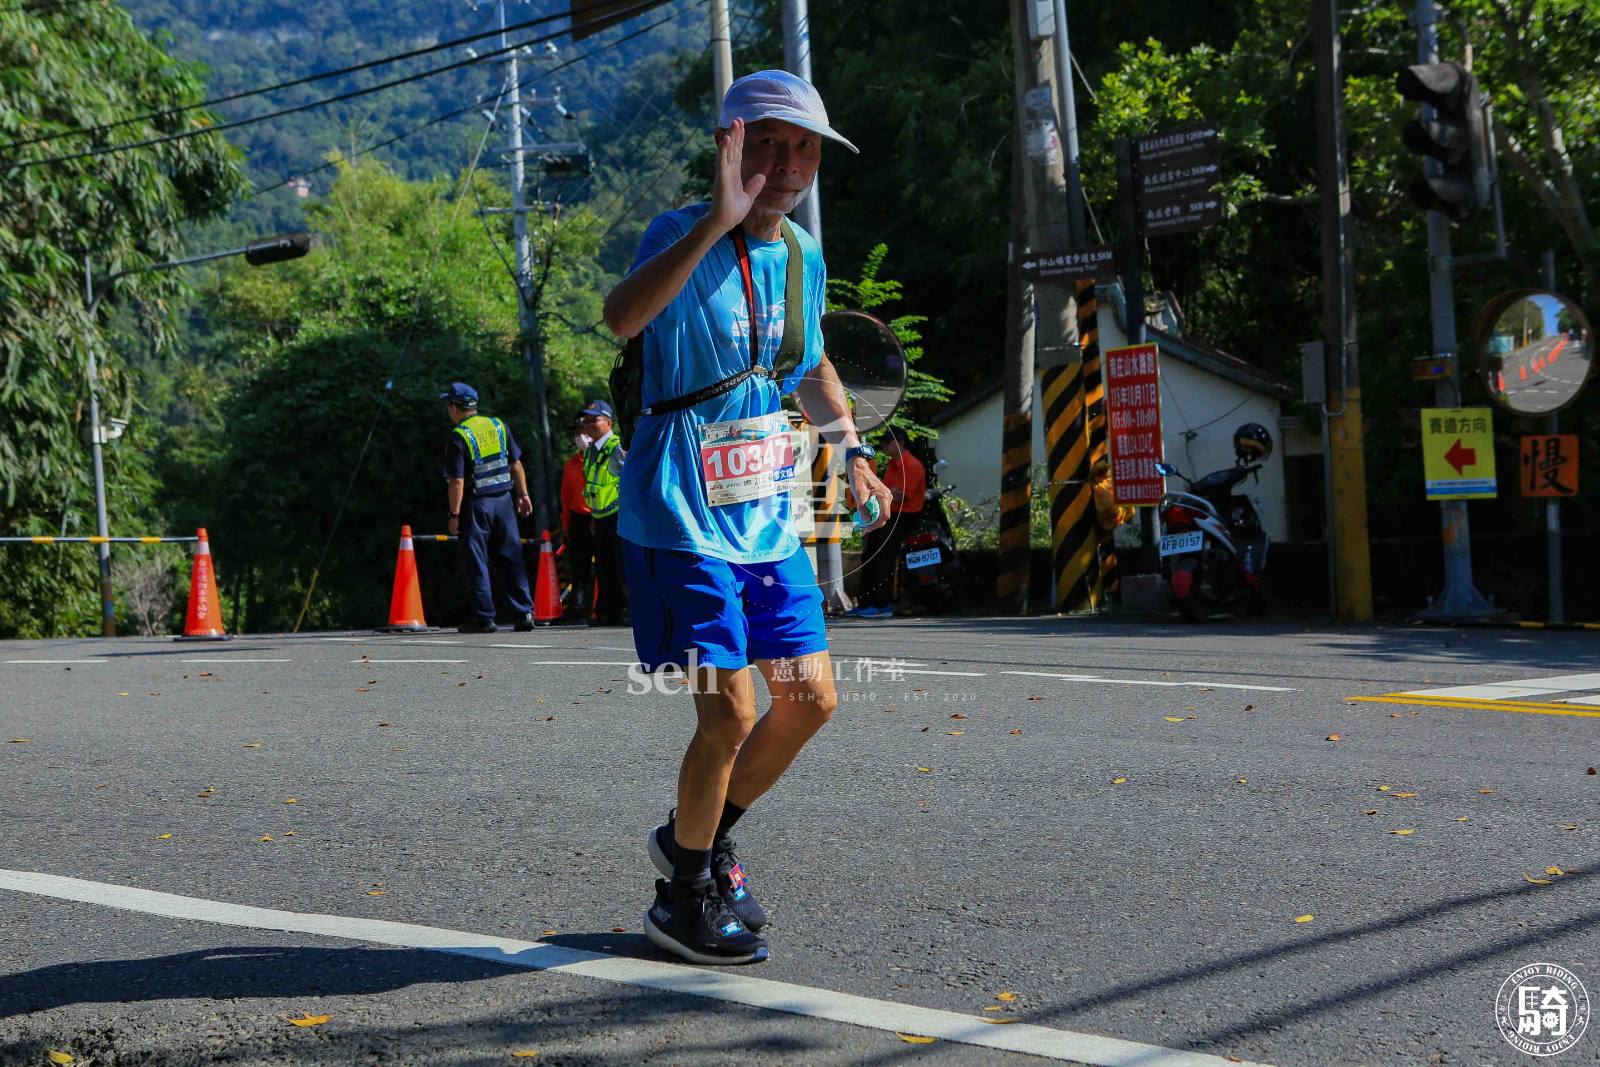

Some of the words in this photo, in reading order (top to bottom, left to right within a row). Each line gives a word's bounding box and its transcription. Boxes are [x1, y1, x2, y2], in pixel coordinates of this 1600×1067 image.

[1429, 416, 1487, 434] 賽道方向
[707, 437, 788, 478] 10347
[1523, 437, 1575, 495] 慢
